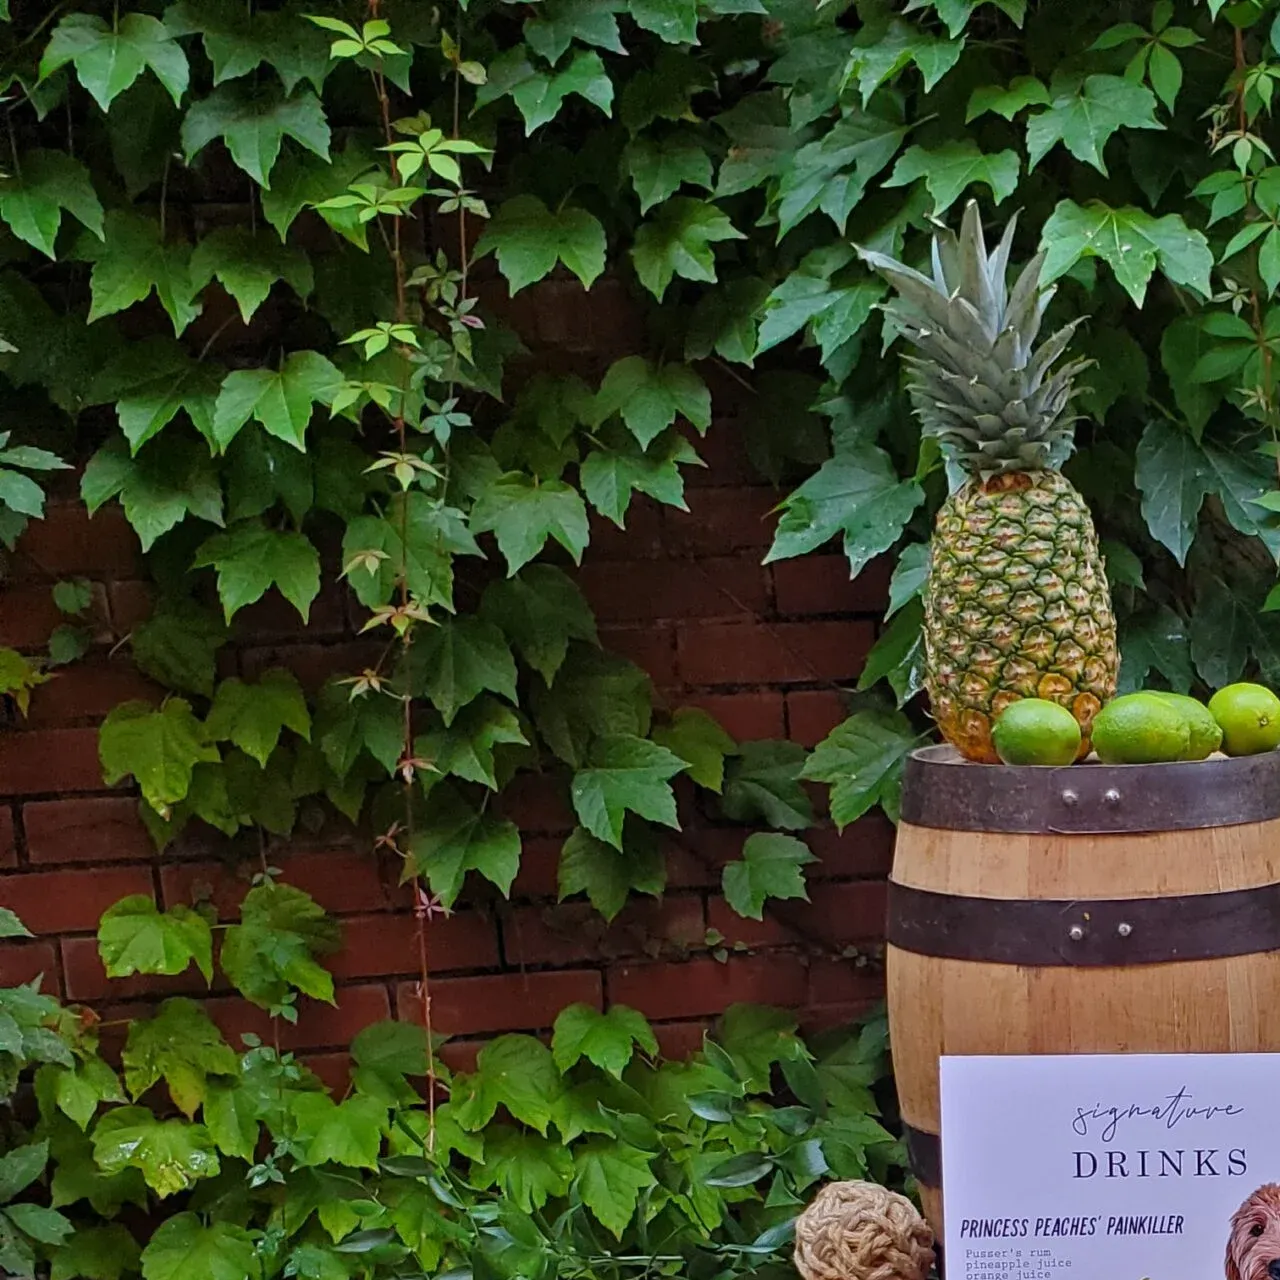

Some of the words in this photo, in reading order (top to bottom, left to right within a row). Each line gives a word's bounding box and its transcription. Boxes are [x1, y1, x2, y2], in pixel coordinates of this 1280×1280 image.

[1072, 1085, 1245, 1143] signature
[1072, 1148, 1248, 1179] DRINKS
[960, 1218, 1029, 1239] PRINCESS
[1034, 1215, 1102, 1237] PEACHES'
[1106, 1215, 1185, 1236] PAINKILLER
[965, 1248, 1022, 1259] Pusser's
[1030, 1248, 1051, 1257] rum
[965, 1259, 1030, 1272] pineapple
[1037, 1258, 1072, 1270] juice
